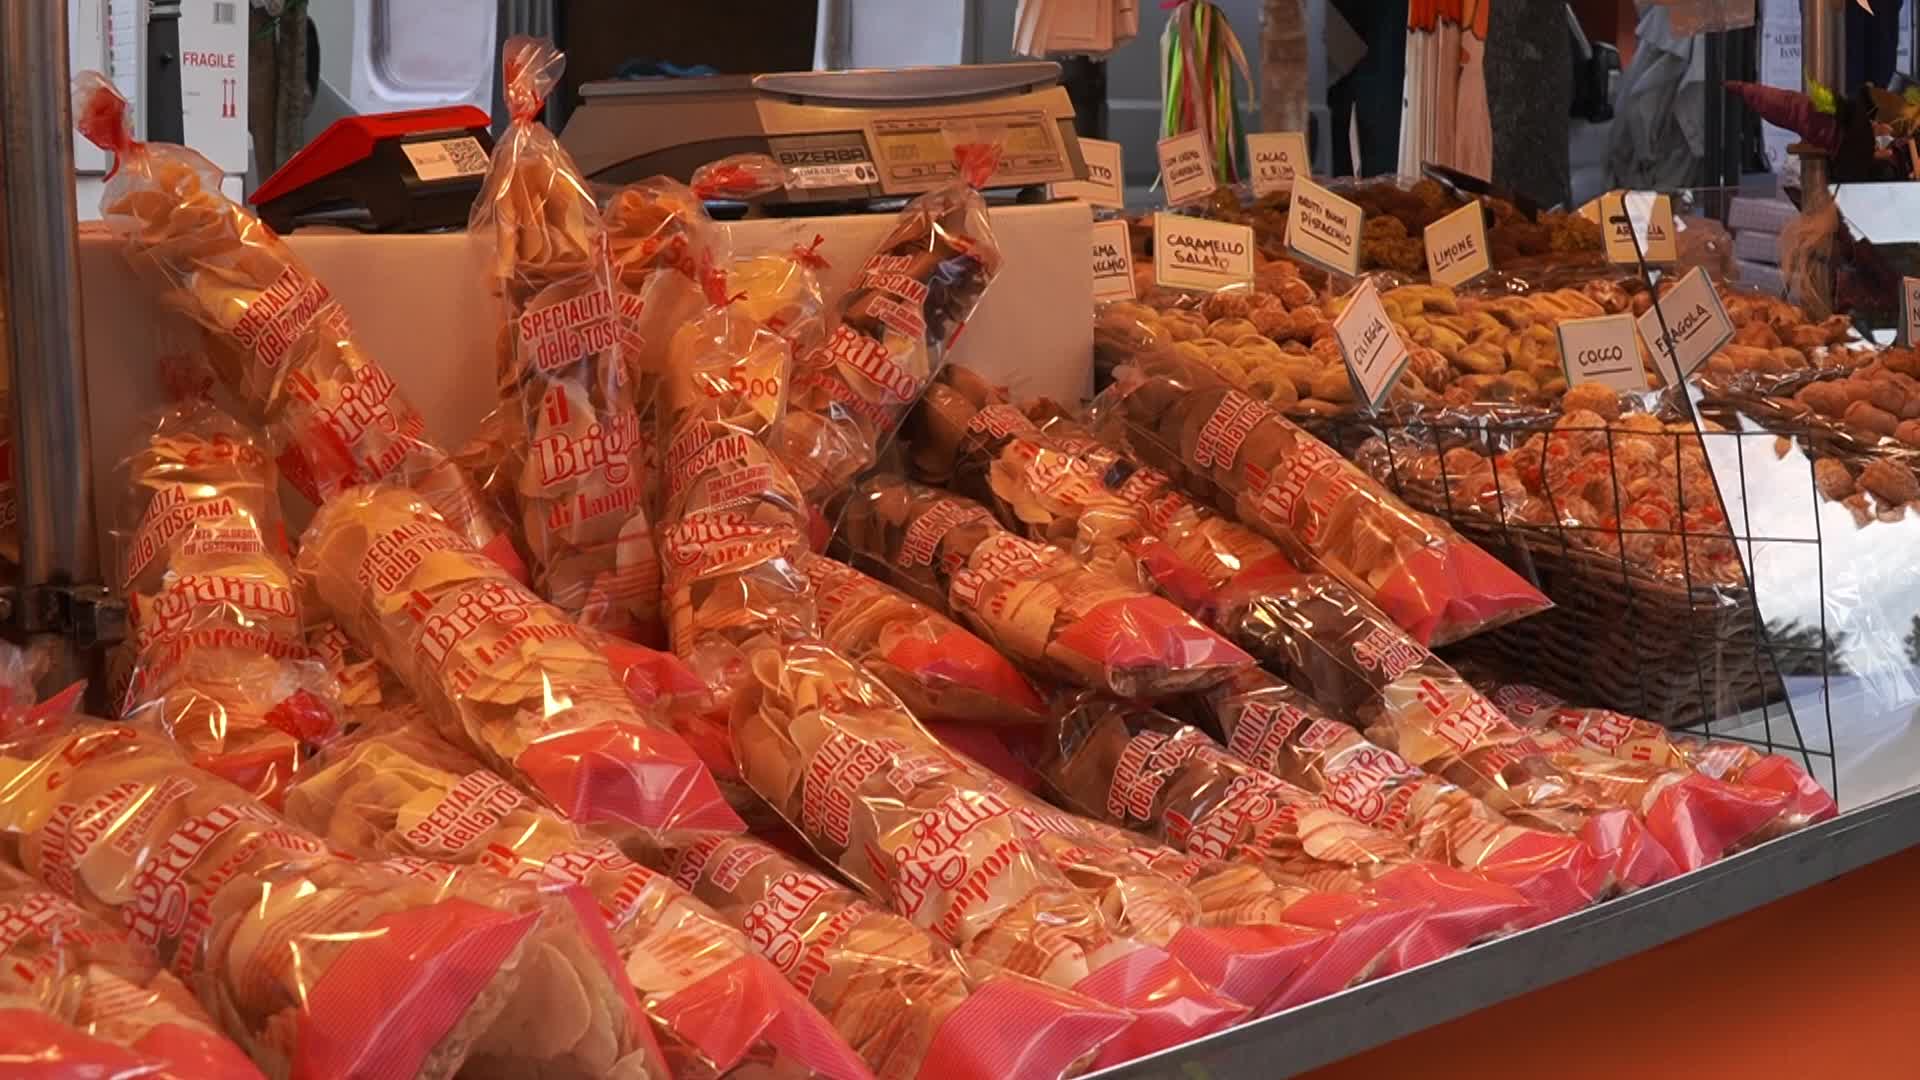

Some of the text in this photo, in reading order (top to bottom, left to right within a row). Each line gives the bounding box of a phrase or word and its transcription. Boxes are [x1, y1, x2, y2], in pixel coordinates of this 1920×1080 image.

[183, 52, 236, 69] FRAGILE
[779, 148, 865, 165] BIZERBA
[1256, 151, 1289, 163] CACAO
[1167, 233, 1244, 257] CARAMELLO
[1174, 250, 1230, 271] SALATO
[1433, 233, 1475, 268] LIMONE
[537, 329, 581, 371] della
[1578, 345, 1623, 367] COCCO
[544, 384, 570, 427] il
[155, 499, 235, 546] TOSCANA
[548, 503, 571, 530] di
[376, 546, 421, 592] della
[1416, 678, 1450, 716] il
[803, 731, 861, 838] SPECIALITA
[442, 810, 496, 852] della
